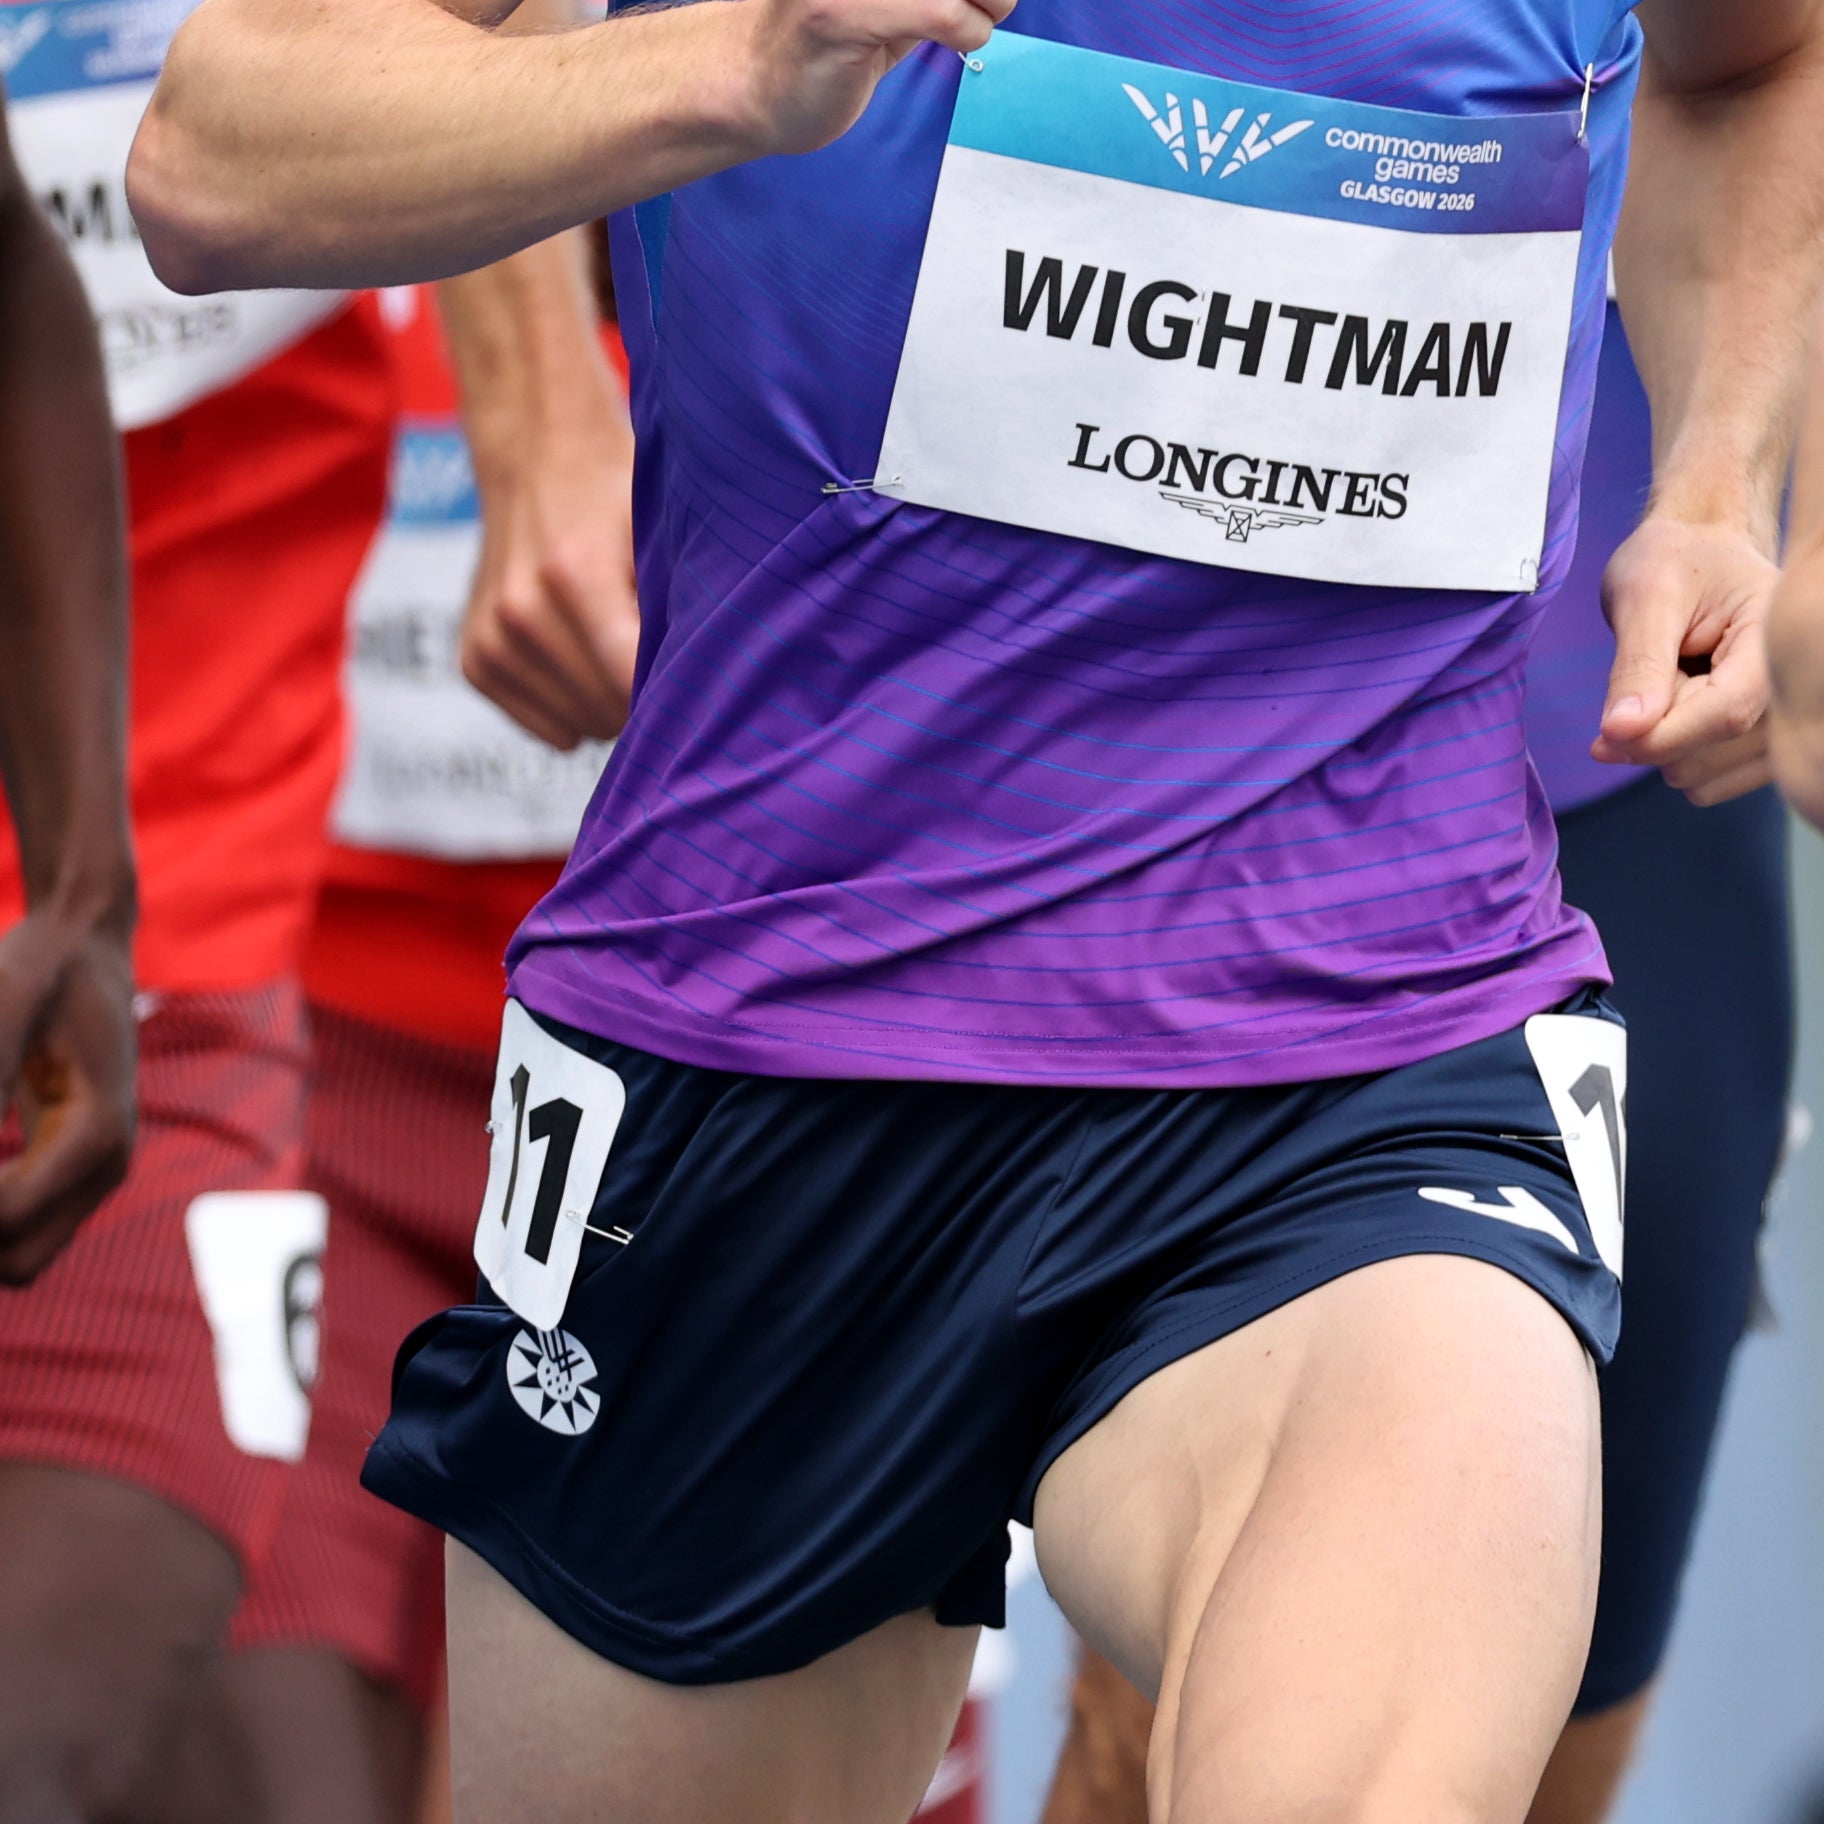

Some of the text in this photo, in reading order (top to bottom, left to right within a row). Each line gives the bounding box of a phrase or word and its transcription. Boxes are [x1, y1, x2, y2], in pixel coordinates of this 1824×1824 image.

[1325, 127, 1503, 164] commonwealth
[1374, 156, 1460, 184] games
[1340, 180, 1475, 211] GLASGOW 2026
[1002, 250, 1513, 398] WIGHTMAN
[1068, 422, 1410, 520] LONGINES
[500, 1062, 584, 1266] 11
